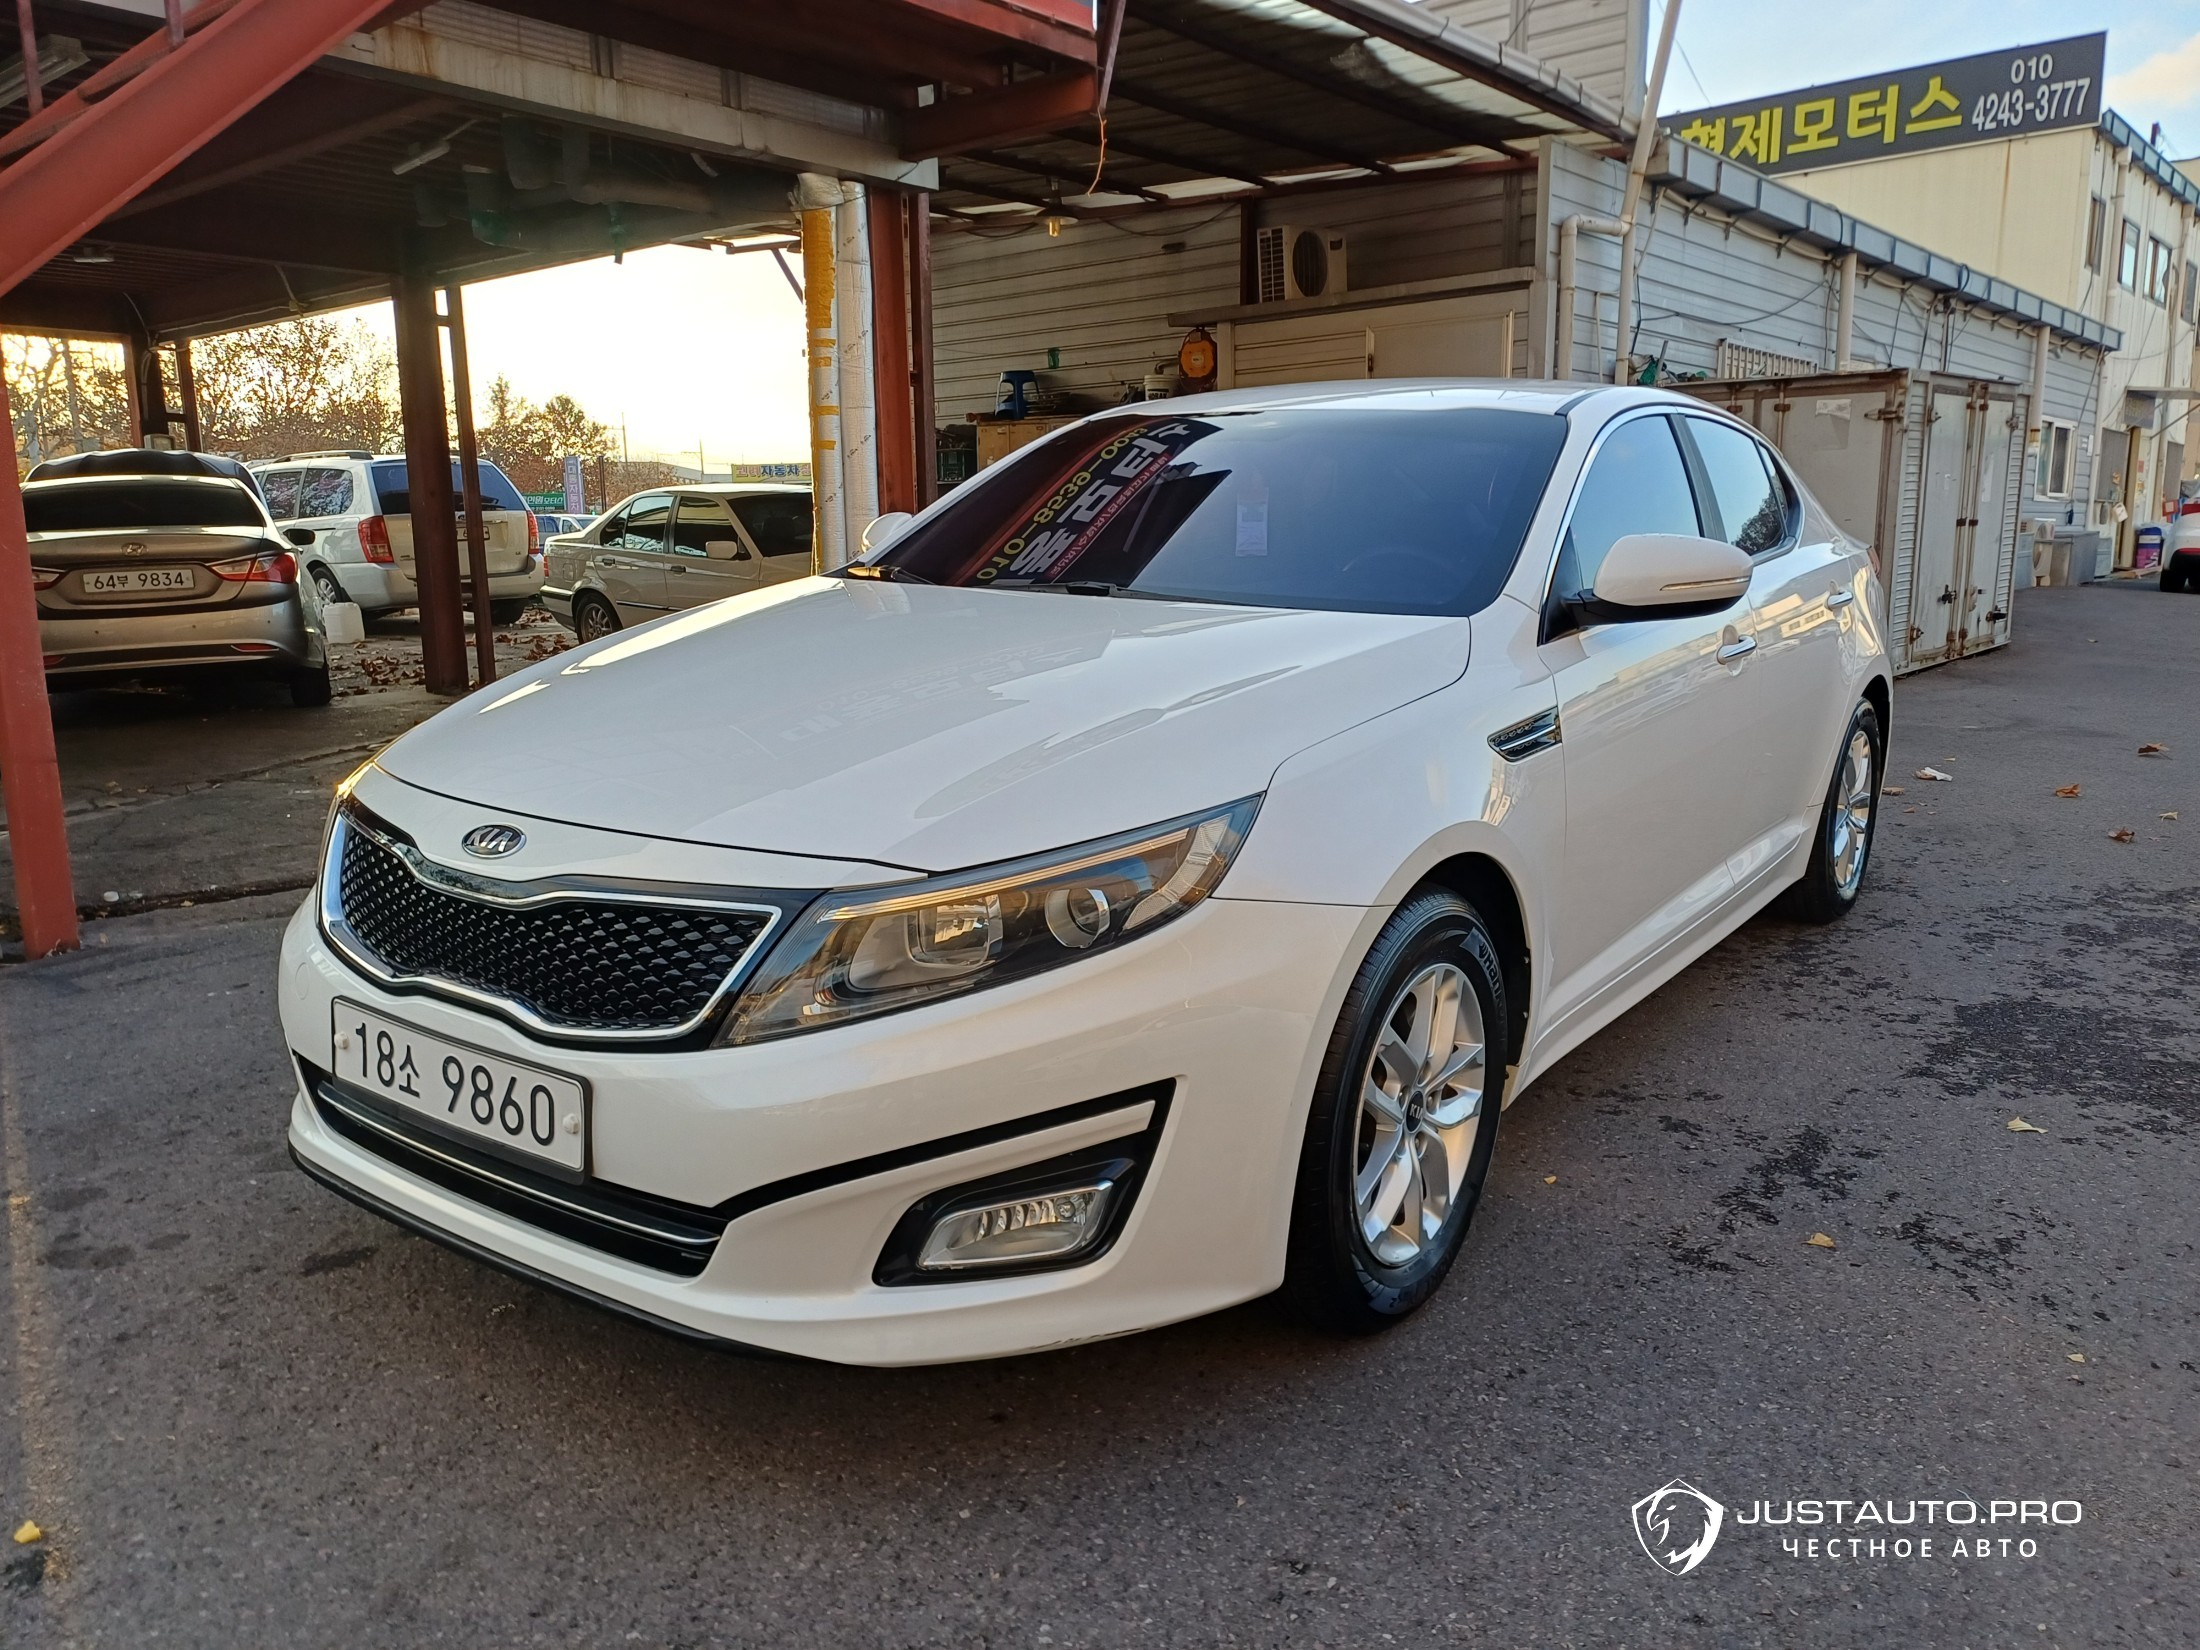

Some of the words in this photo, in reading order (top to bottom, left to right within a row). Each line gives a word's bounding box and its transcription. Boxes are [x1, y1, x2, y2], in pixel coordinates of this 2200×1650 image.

[2011, 54, 2053, 84] 010
[1681, 76, 1962, 164] 형제모터스
[1972, 77, 2092, 132] 4243-3777
[94, 574, 128, 590] 64부
[138, 571, 184, 588] 9834
[465, 826, 513, 853] KIA
[354, 1021, 421, 1098] 18소
[441, 1054, 556, 1147] 9860
